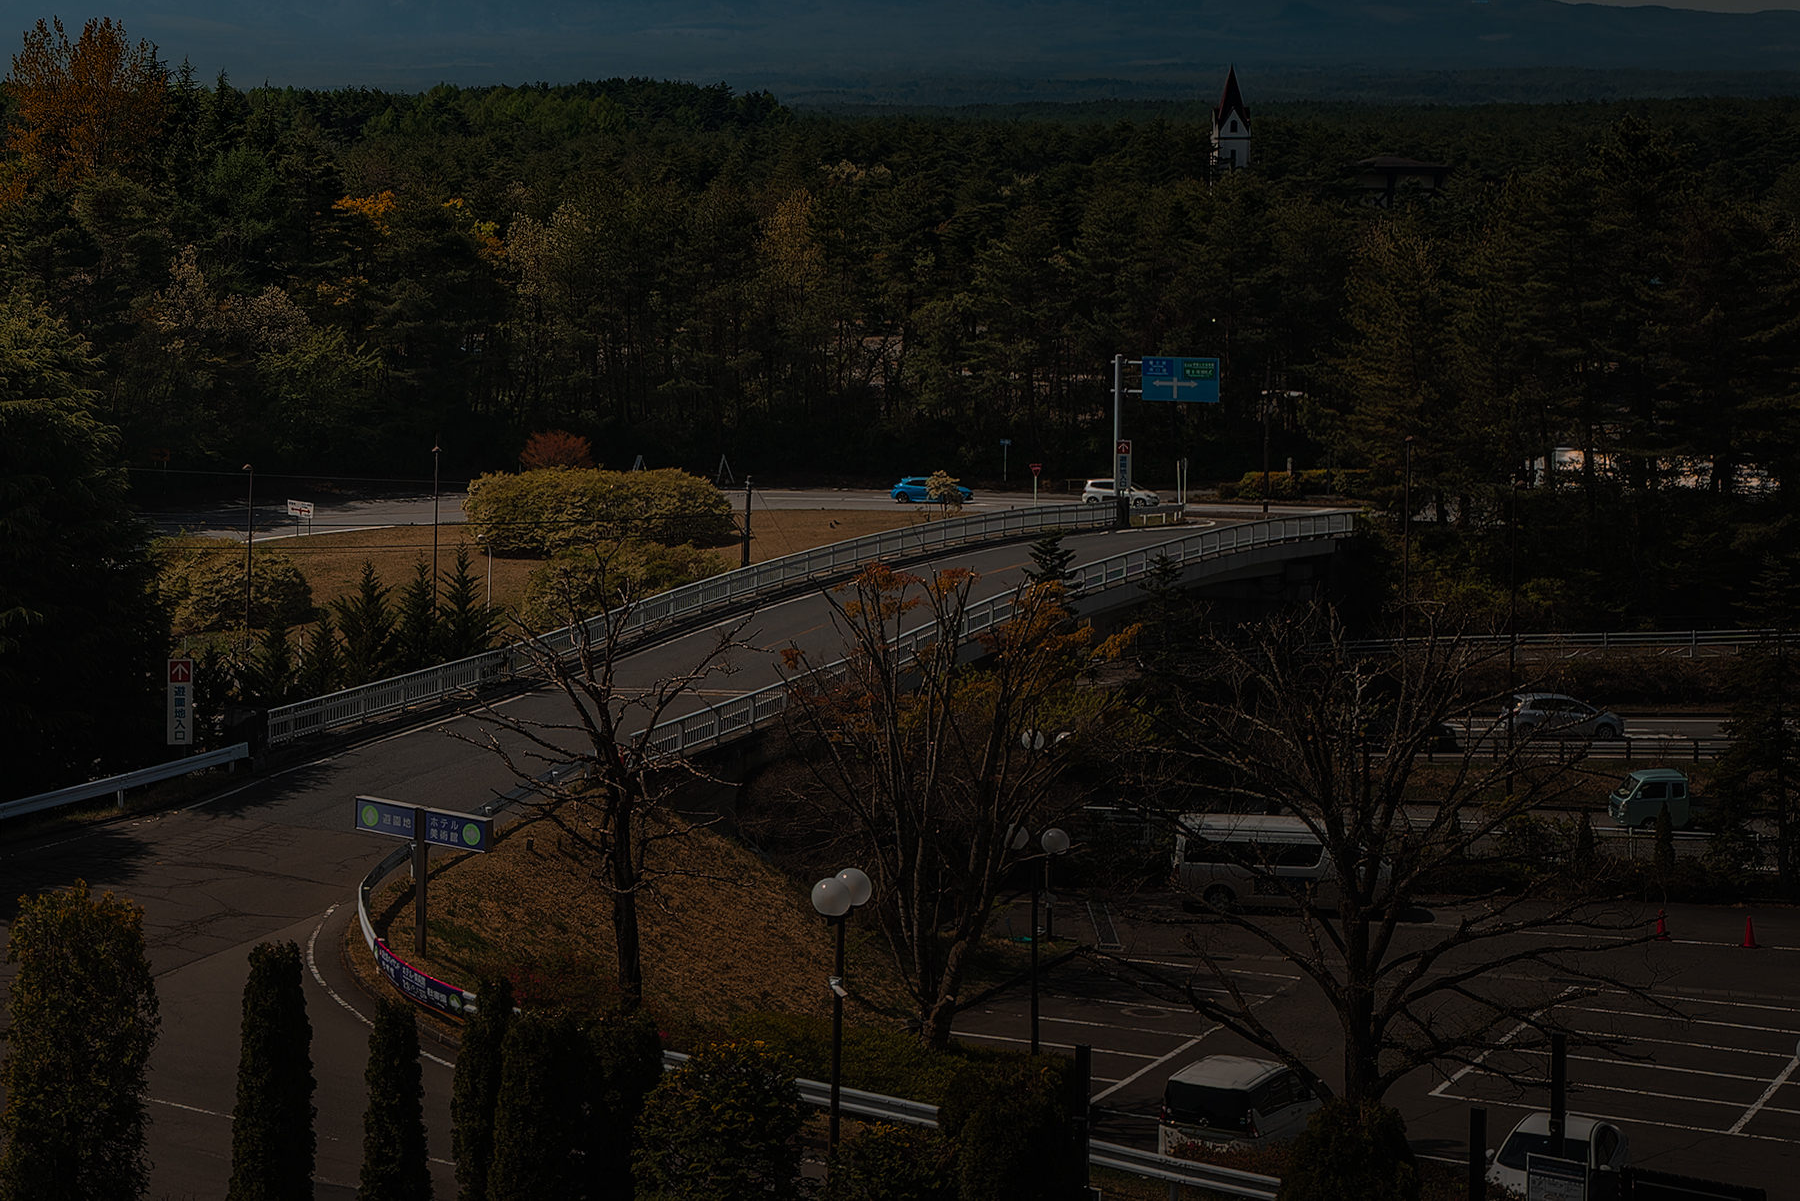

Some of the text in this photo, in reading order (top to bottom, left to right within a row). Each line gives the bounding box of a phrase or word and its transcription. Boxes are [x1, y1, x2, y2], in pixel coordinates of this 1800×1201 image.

[174, 685, 186, 740] 遊園地入口
[382, 813, 412, 829] 遊園地
[430, 816, 459, 831] ホテル
